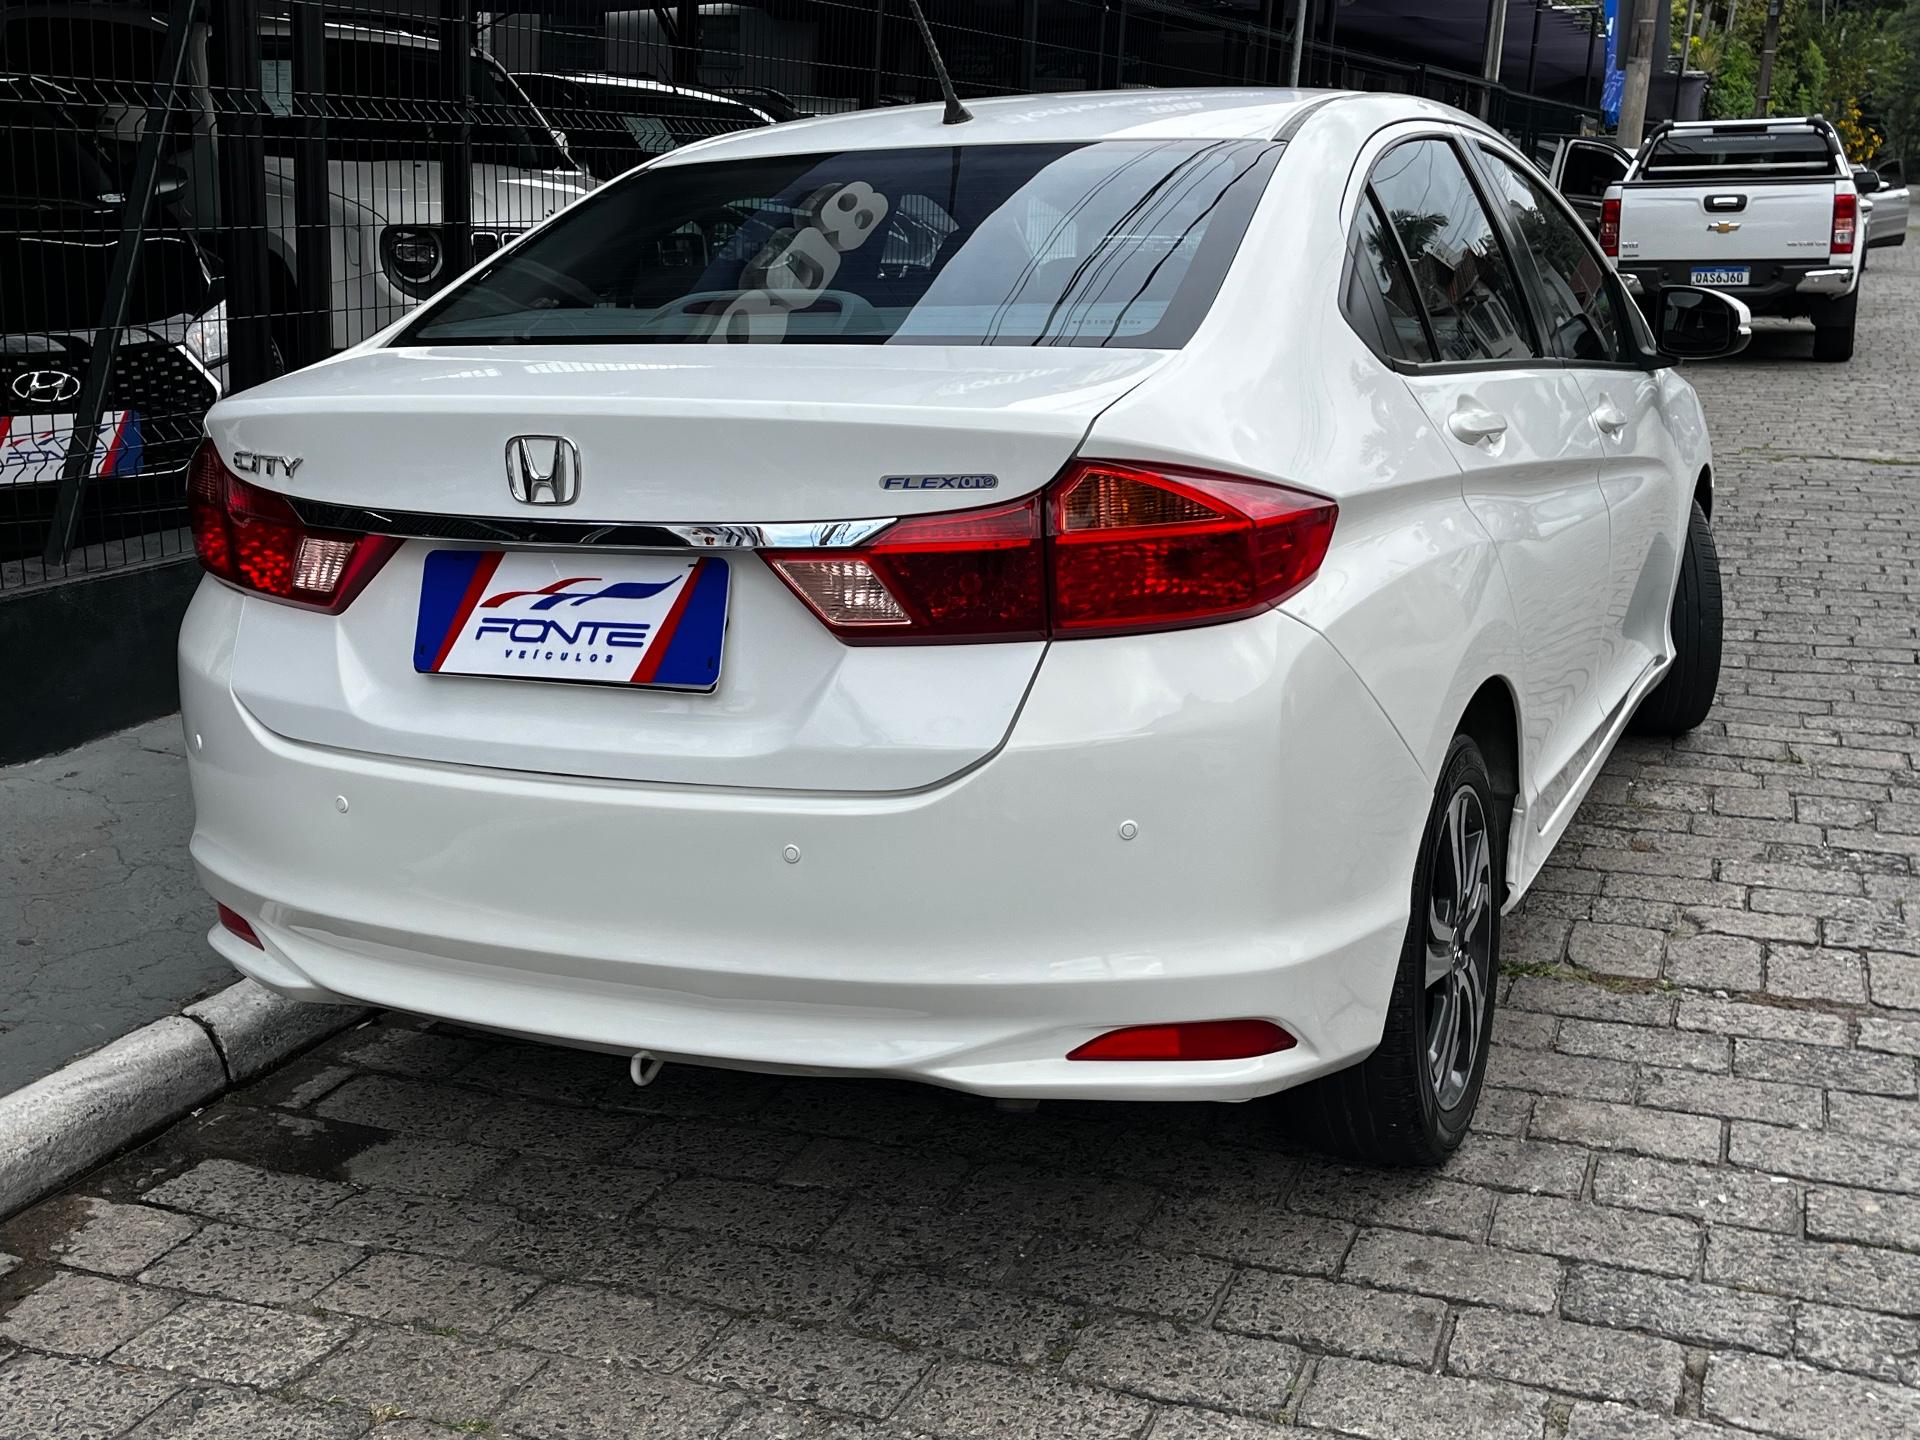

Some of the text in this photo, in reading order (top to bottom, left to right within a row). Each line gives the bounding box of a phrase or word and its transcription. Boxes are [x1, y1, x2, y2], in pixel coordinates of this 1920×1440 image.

[233, 451, 304, 478] CITY
[475, 617, 651, 648] FONTE
[505, 649, 614, 663] VEÍCULOS
